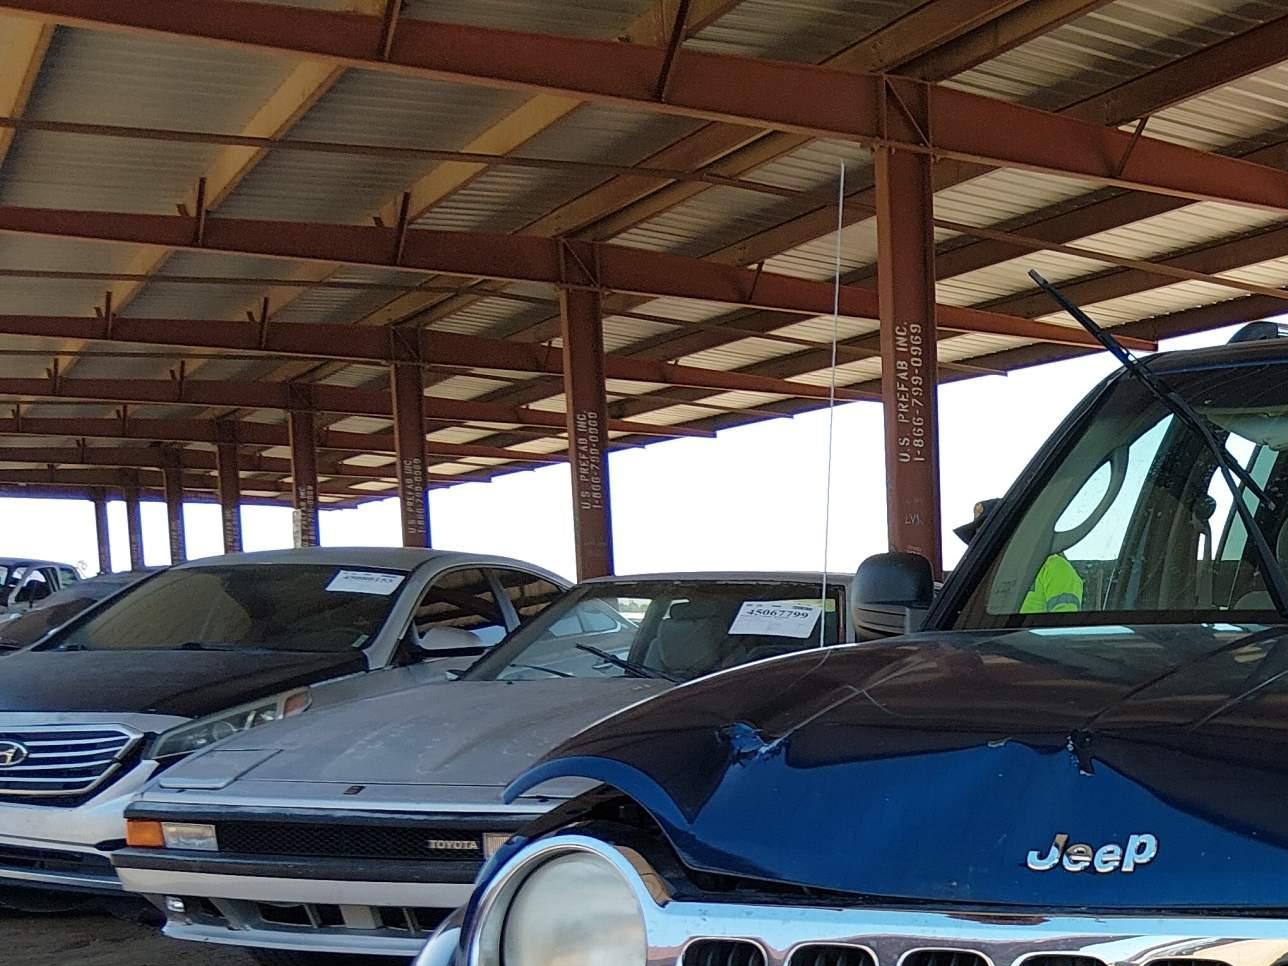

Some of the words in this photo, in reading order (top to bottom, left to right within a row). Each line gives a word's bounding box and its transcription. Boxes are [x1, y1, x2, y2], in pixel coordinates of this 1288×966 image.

[896, 321, 908, 352] INC.
[896, 360, 909, 423] PREFAB
[910, 323, 925, 461] 1-866-799-0969
[746, 609, 809, 618] 45067799
[428, 840, 479, 849] TOYOTA
[1027, 834, 1158, 872] Jeep
